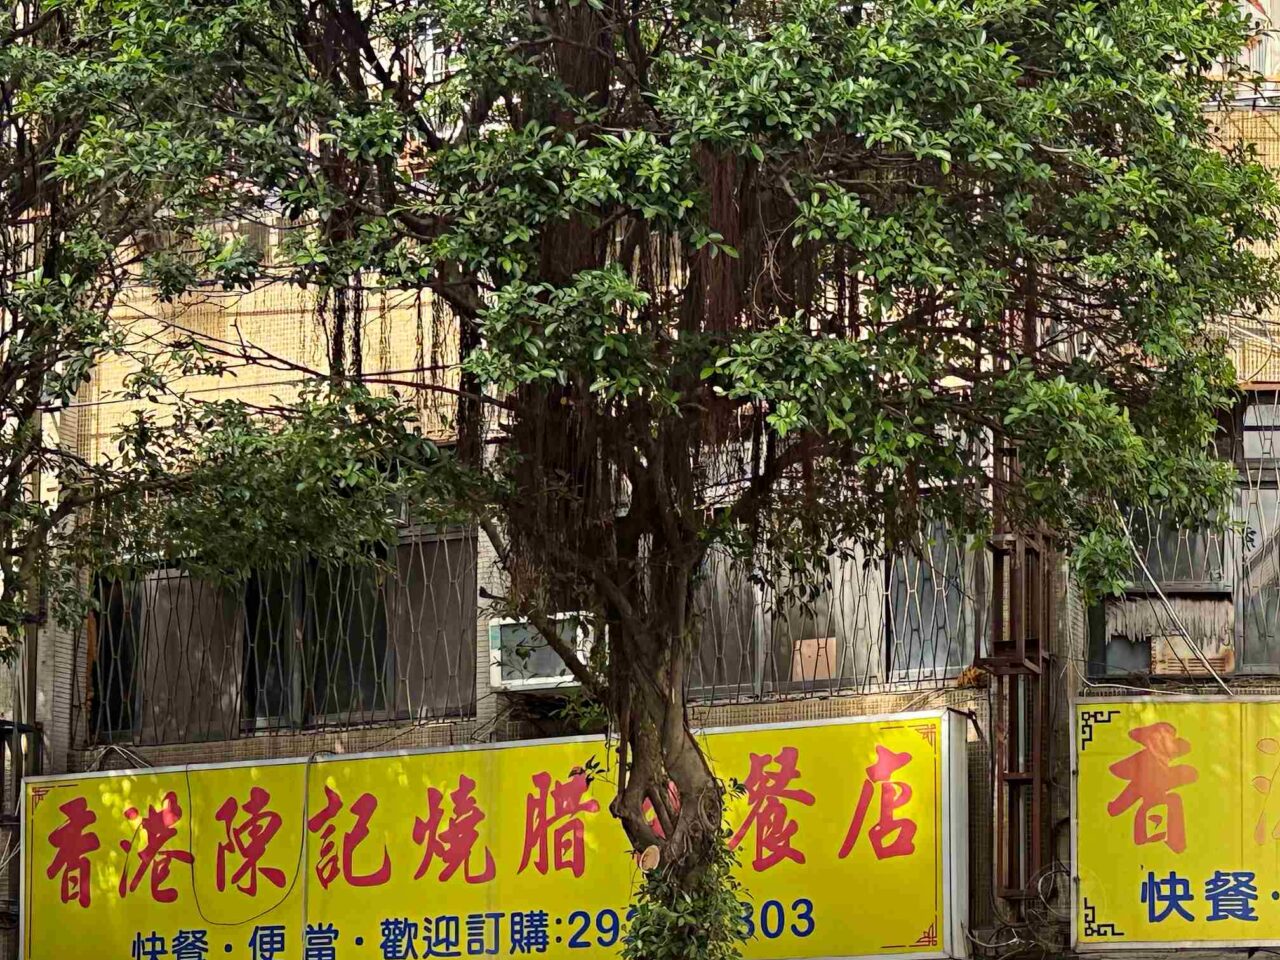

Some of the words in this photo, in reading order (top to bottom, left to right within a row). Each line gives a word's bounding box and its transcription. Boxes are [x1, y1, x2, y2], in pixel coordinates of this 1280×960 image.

[46, 744, 918, 908] 香港陳記燒腊餐店
